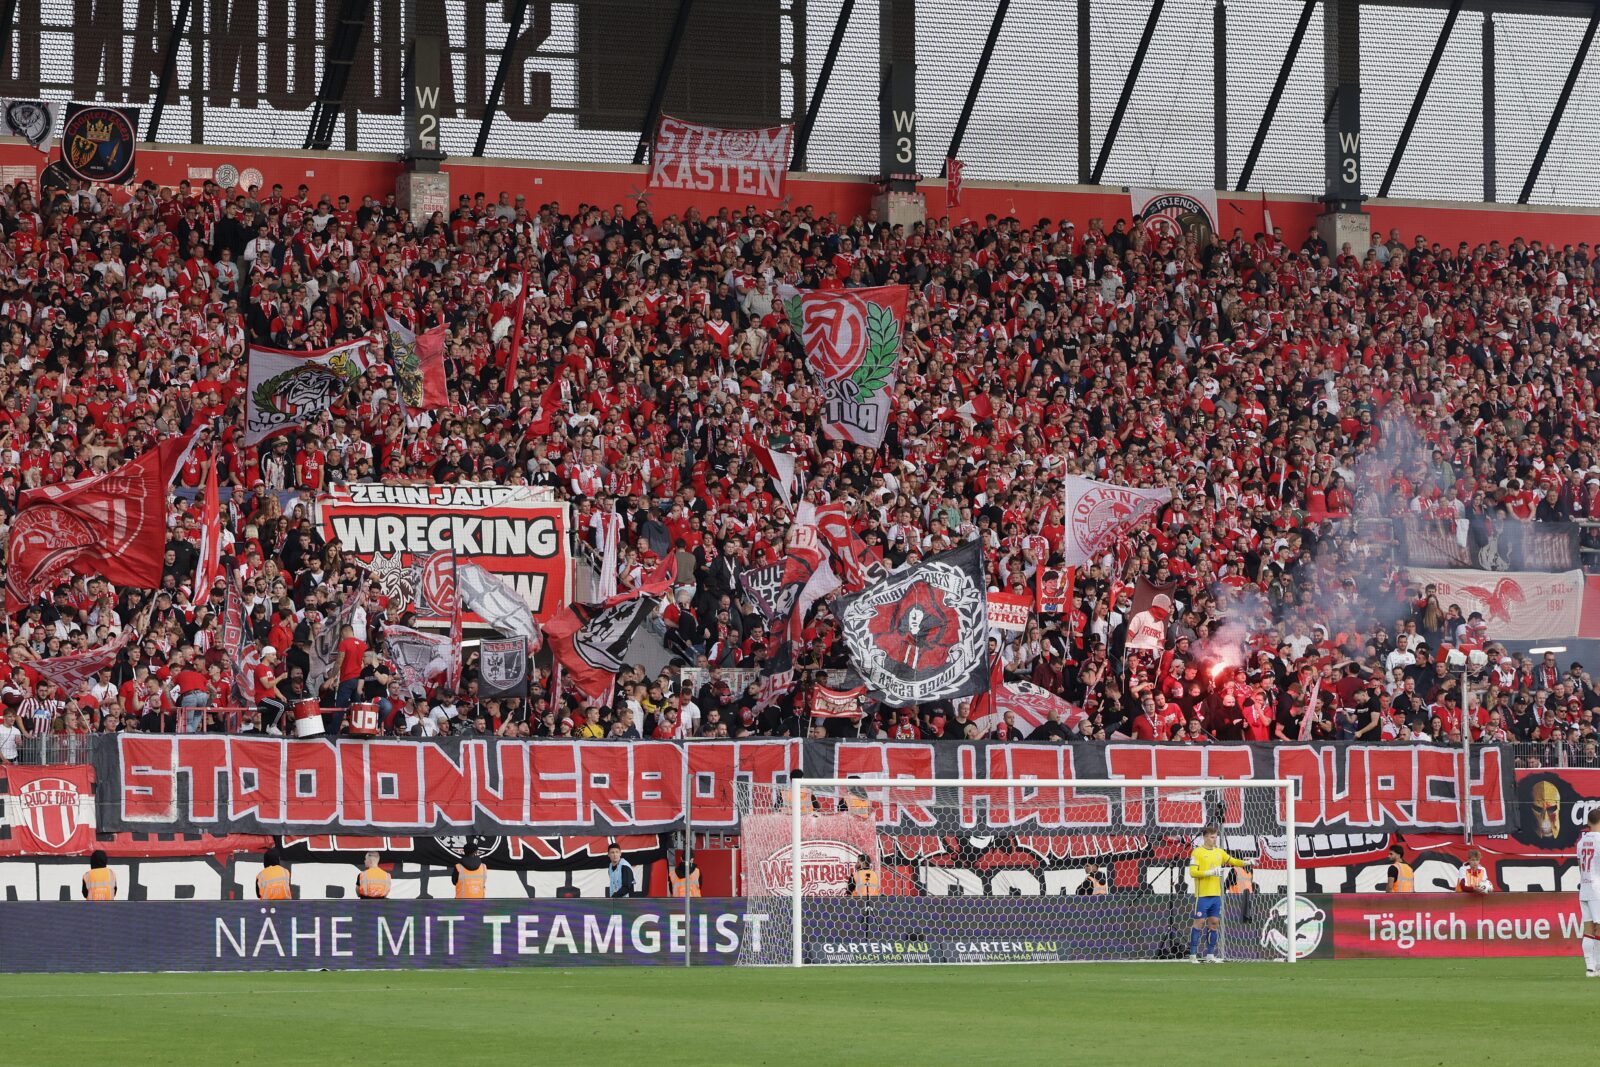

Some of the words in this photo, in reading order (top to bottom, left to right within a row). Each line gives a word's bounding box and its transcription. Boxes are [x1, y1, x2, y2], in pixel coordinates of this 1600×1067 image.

[415, 86, 440, 110] W
[418, 114, 437, 141] 2
[892, 110, 916, 133] W
[896, 137, 913, 163] 3
[1338, 132, 1360, 154] W
[649, 152, 784, 197] KASTEN
[1342, 158, 1358, 183] 3
[1155, 197, 1200, 214] FRIENDS
[258, 412, 286, 424] 10
[349, 485, 429, 505] ZEHN
[1073, 494, 1097, 523] LOS
[331, 514, 559, 557] WRECKING
[986, 601, 1029, 613] REAKS
[957, 741, 1255, 830] HALTET
[1273, 742, 1506, 828] DURCH
[24, 790, 52, 806] RUDE
[1581, 848, 1595, 873] 37
[215, 907, 353, 958] NÄHE
[376, 915, 465, 957] MIT
[482, 912, 770, 957] TEAMGEIST
[1363, 911, 1467, 949] Täglich
[1476, 917, 1551, 940] neue
[822, 942, 929, 954] GARTENBAU
[855, 953, 880, 961] NACH
[955, 941, 1058, 953] GARTENBAU
[986, 953, 1010, 961] NACH
